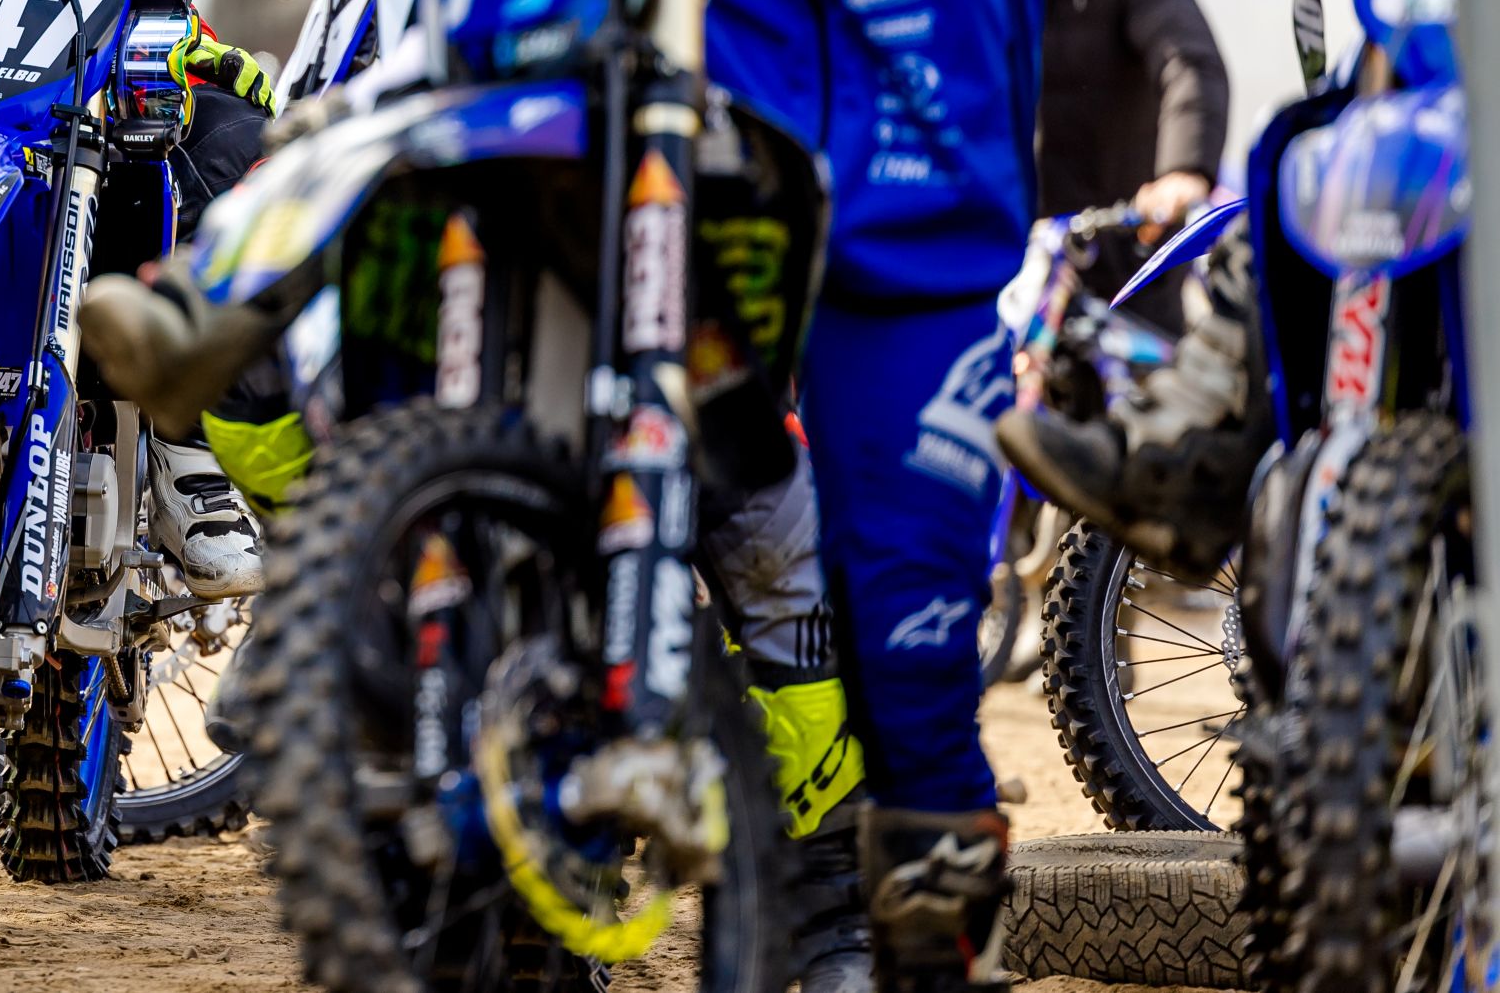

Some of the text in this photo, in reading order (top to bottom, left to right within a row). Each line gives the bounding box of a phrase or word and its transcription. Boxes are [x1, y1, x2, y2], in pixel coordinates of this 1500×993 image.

[123, 134, 155, 142] OAKLEY
[21, 413, 52, 602] DUNLOP
[52, 448, 72, 525] YAMALUBE
